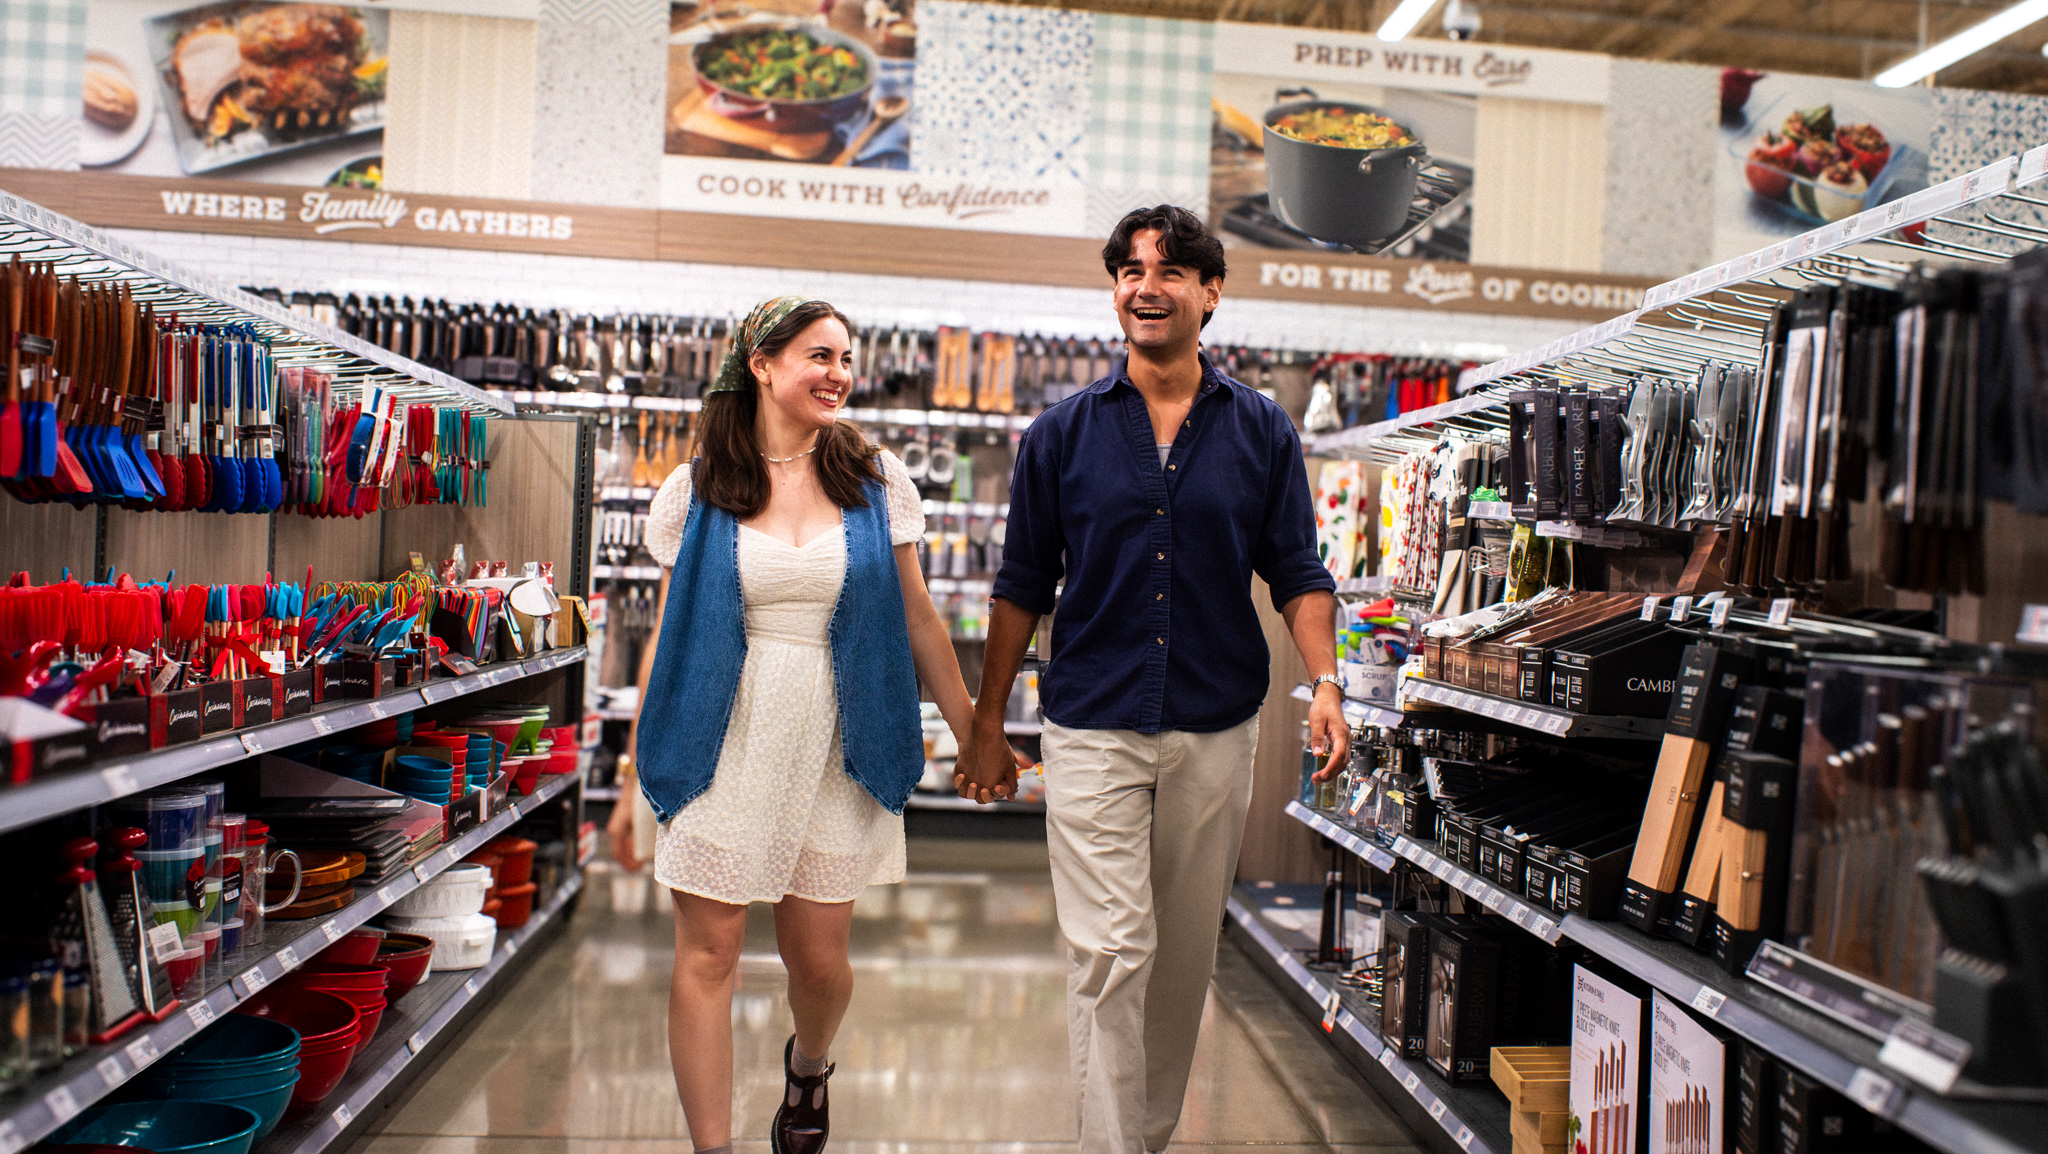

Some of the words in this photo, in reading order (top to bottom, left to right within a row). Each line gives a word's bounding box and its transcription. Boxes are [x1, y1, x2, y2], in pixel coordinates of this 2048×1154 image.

[1294, 43, 1372, 69] PREP
[1382, 50, 1463, 76] WITH
[1473, 51, 1532, 79] Ease
[160, 190, 287, 221] WHERE
[300, 191, 408, 228] Family
[414, 206, 574, 241] GATHERS
[697, 174, 787, 199] COOK
[799, 181, 886, 205] WITH
[898, 183, 1050, 215] Confidence
[1259, 262, 1322, 288] FOR
[1328, 266, 1393, 293] THE
[1403, 263, 1475, 299] Love
[1481, 276, 1523, 302] OF
[1529, 279, 1645, 310] COOKIN
[1541, 397, 1556, 491] ARBERWARE
[1571, 400, 1587, 497] FARBERWARE
[1408, 1038, 1424, 1050] 20
[1457, 1060, 1474, 1073] 20
